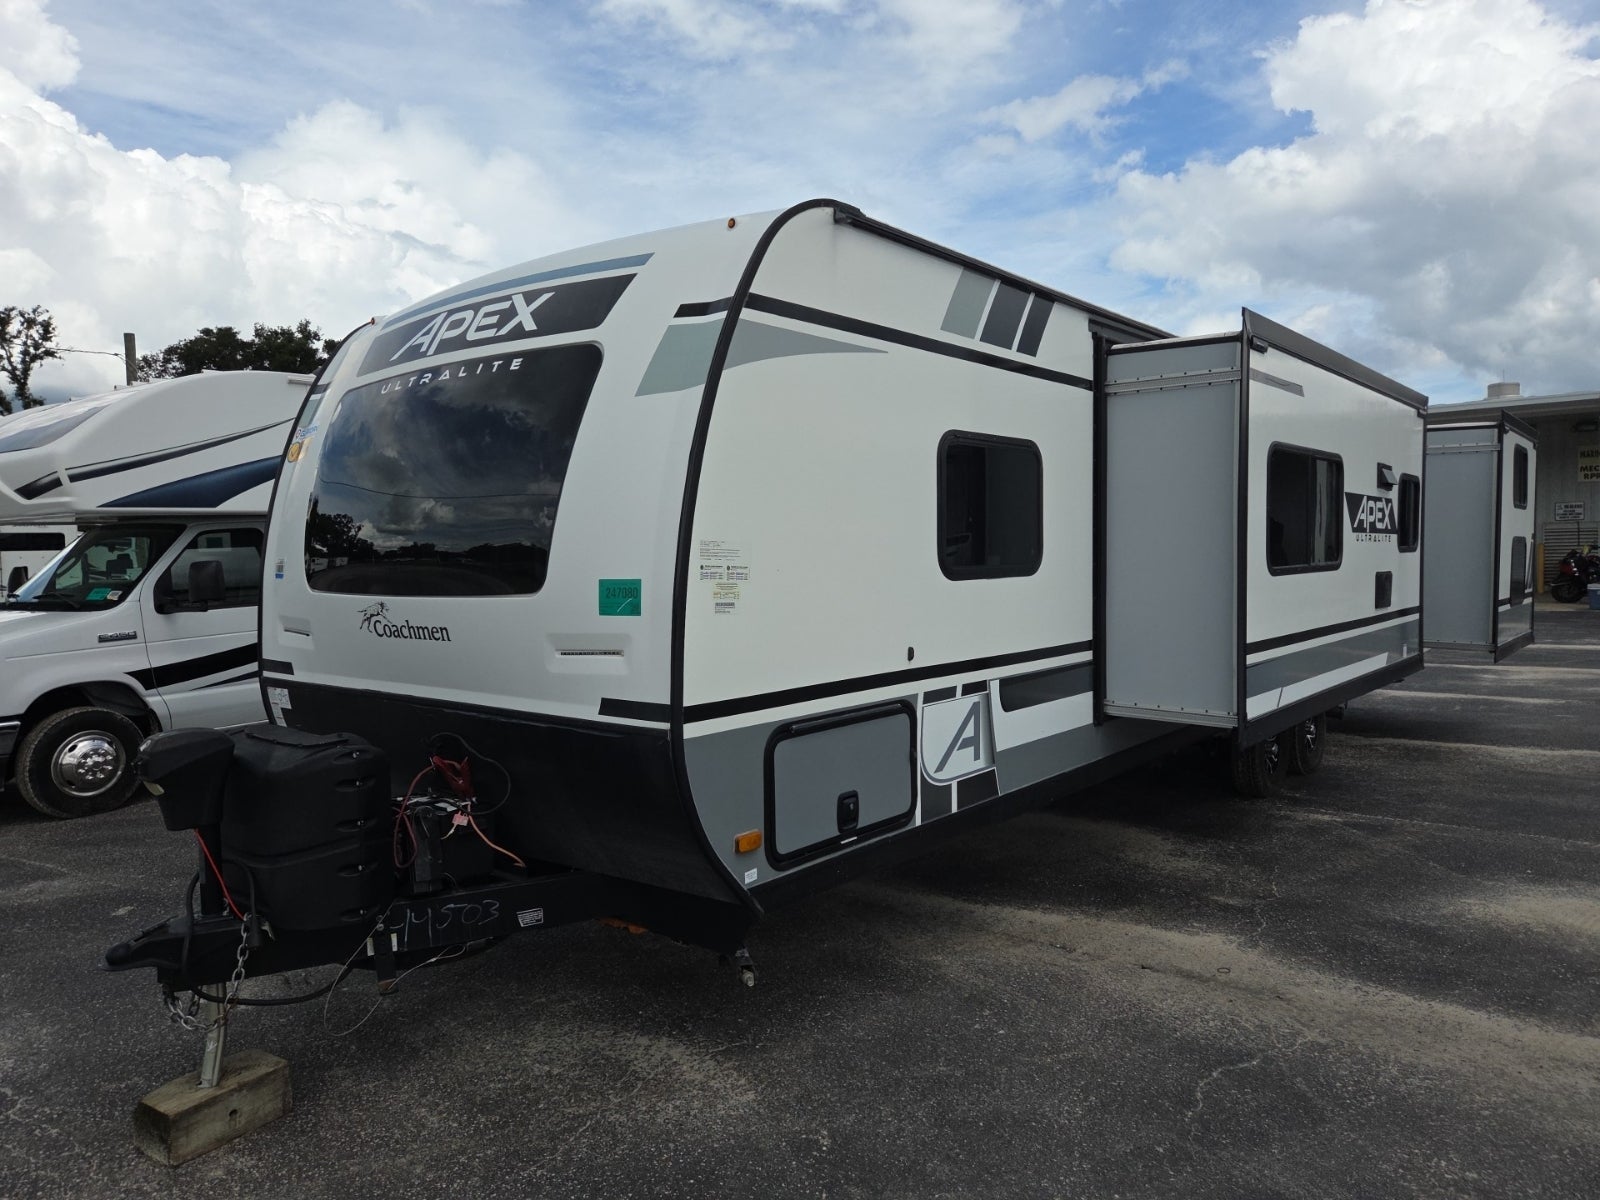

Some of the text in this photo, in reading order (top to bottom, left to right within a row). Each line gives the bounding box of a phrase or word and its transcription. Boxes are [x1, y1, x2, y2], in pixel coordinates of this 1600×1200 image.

[389, 291, 555, 361] APEX
[381, 357, 523, 394] ULTRALITE
[1353, 495, 1391, 533] APEX
[605, 586, 639, 599] 247080
[373, 619, 452, 642] Coachmen
[933, 700, 981, 774] A
